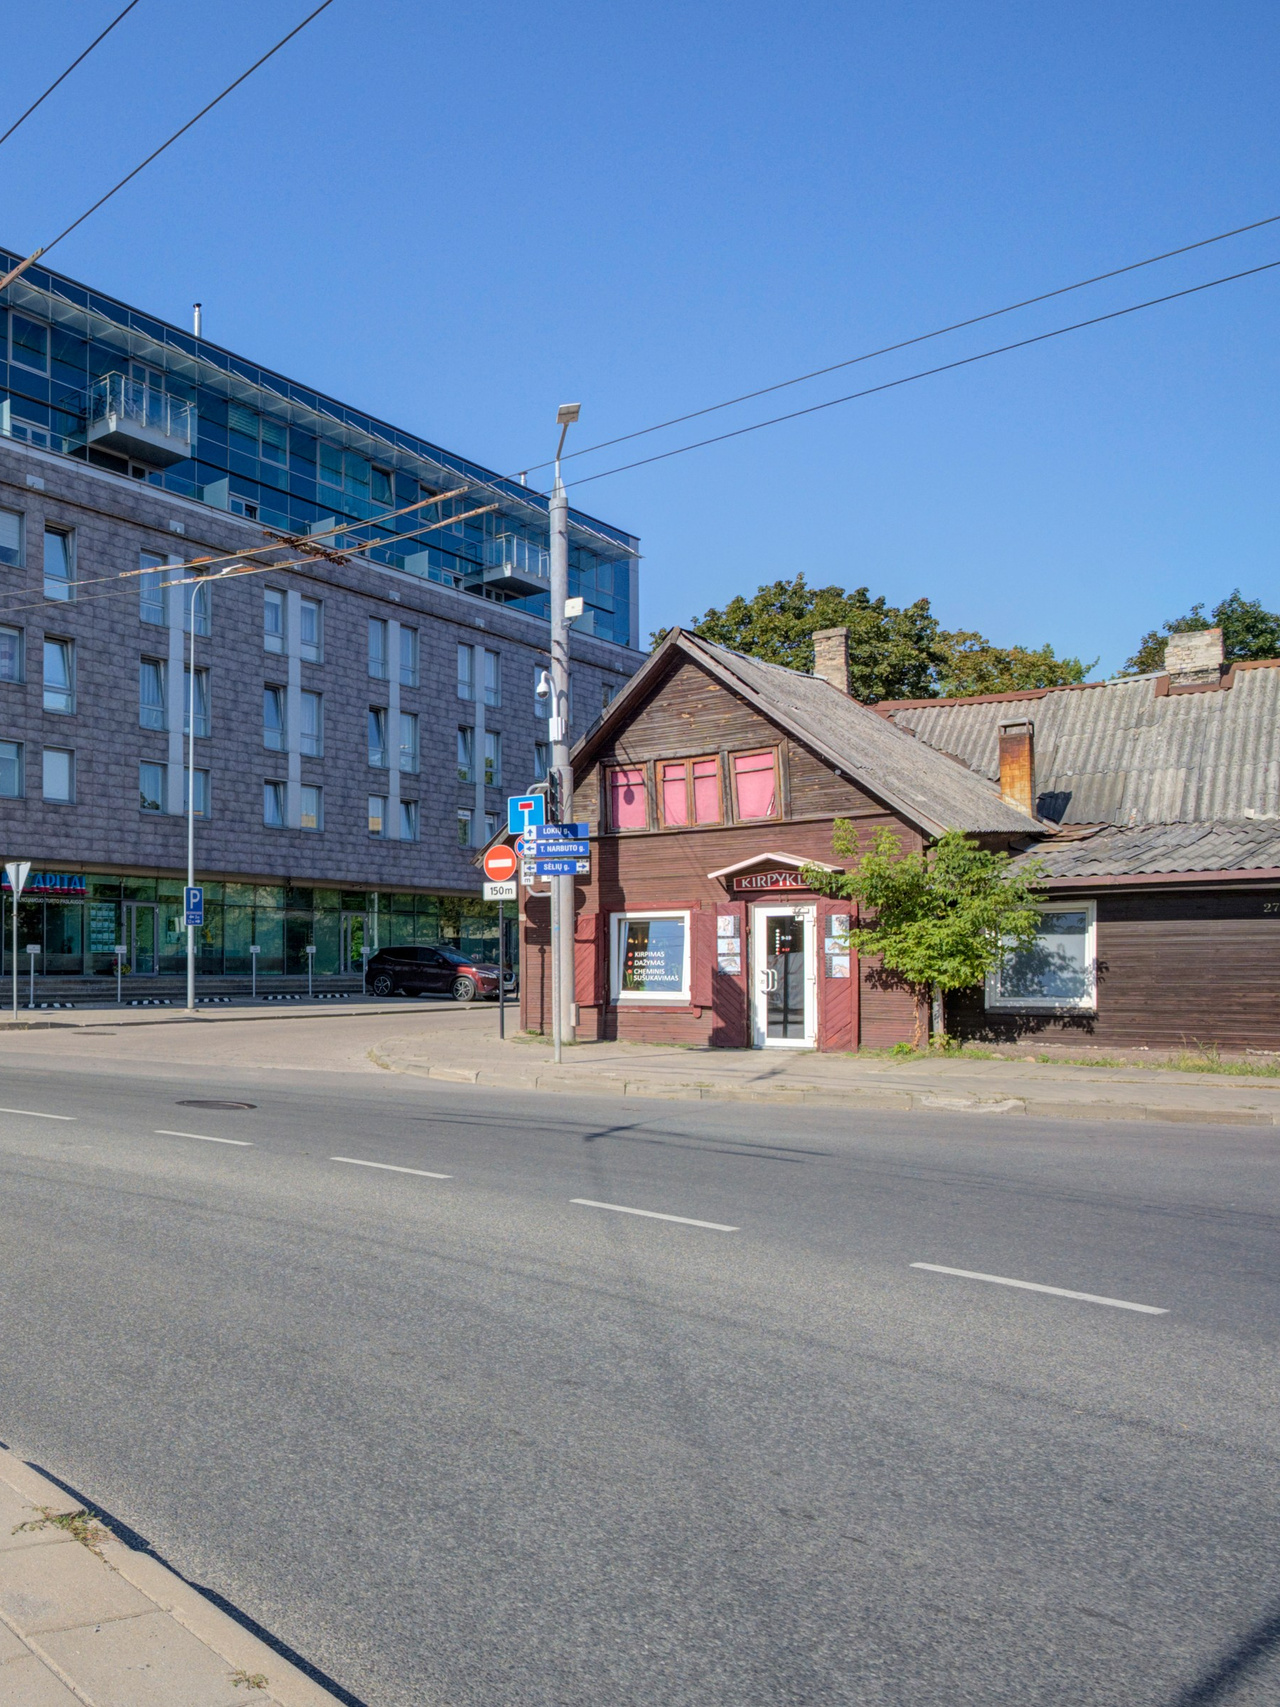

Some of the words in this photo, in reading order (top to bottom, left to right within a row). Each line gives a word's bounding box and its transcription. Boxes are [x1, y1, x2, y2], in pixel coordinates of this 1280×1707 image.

[543, 827, 562, 835] LOKIŲ
[543, 862, 562, 872] SĖLIŲ
[190, 890, 200, 909] P
[1263, 902, 1280, 912] 27
